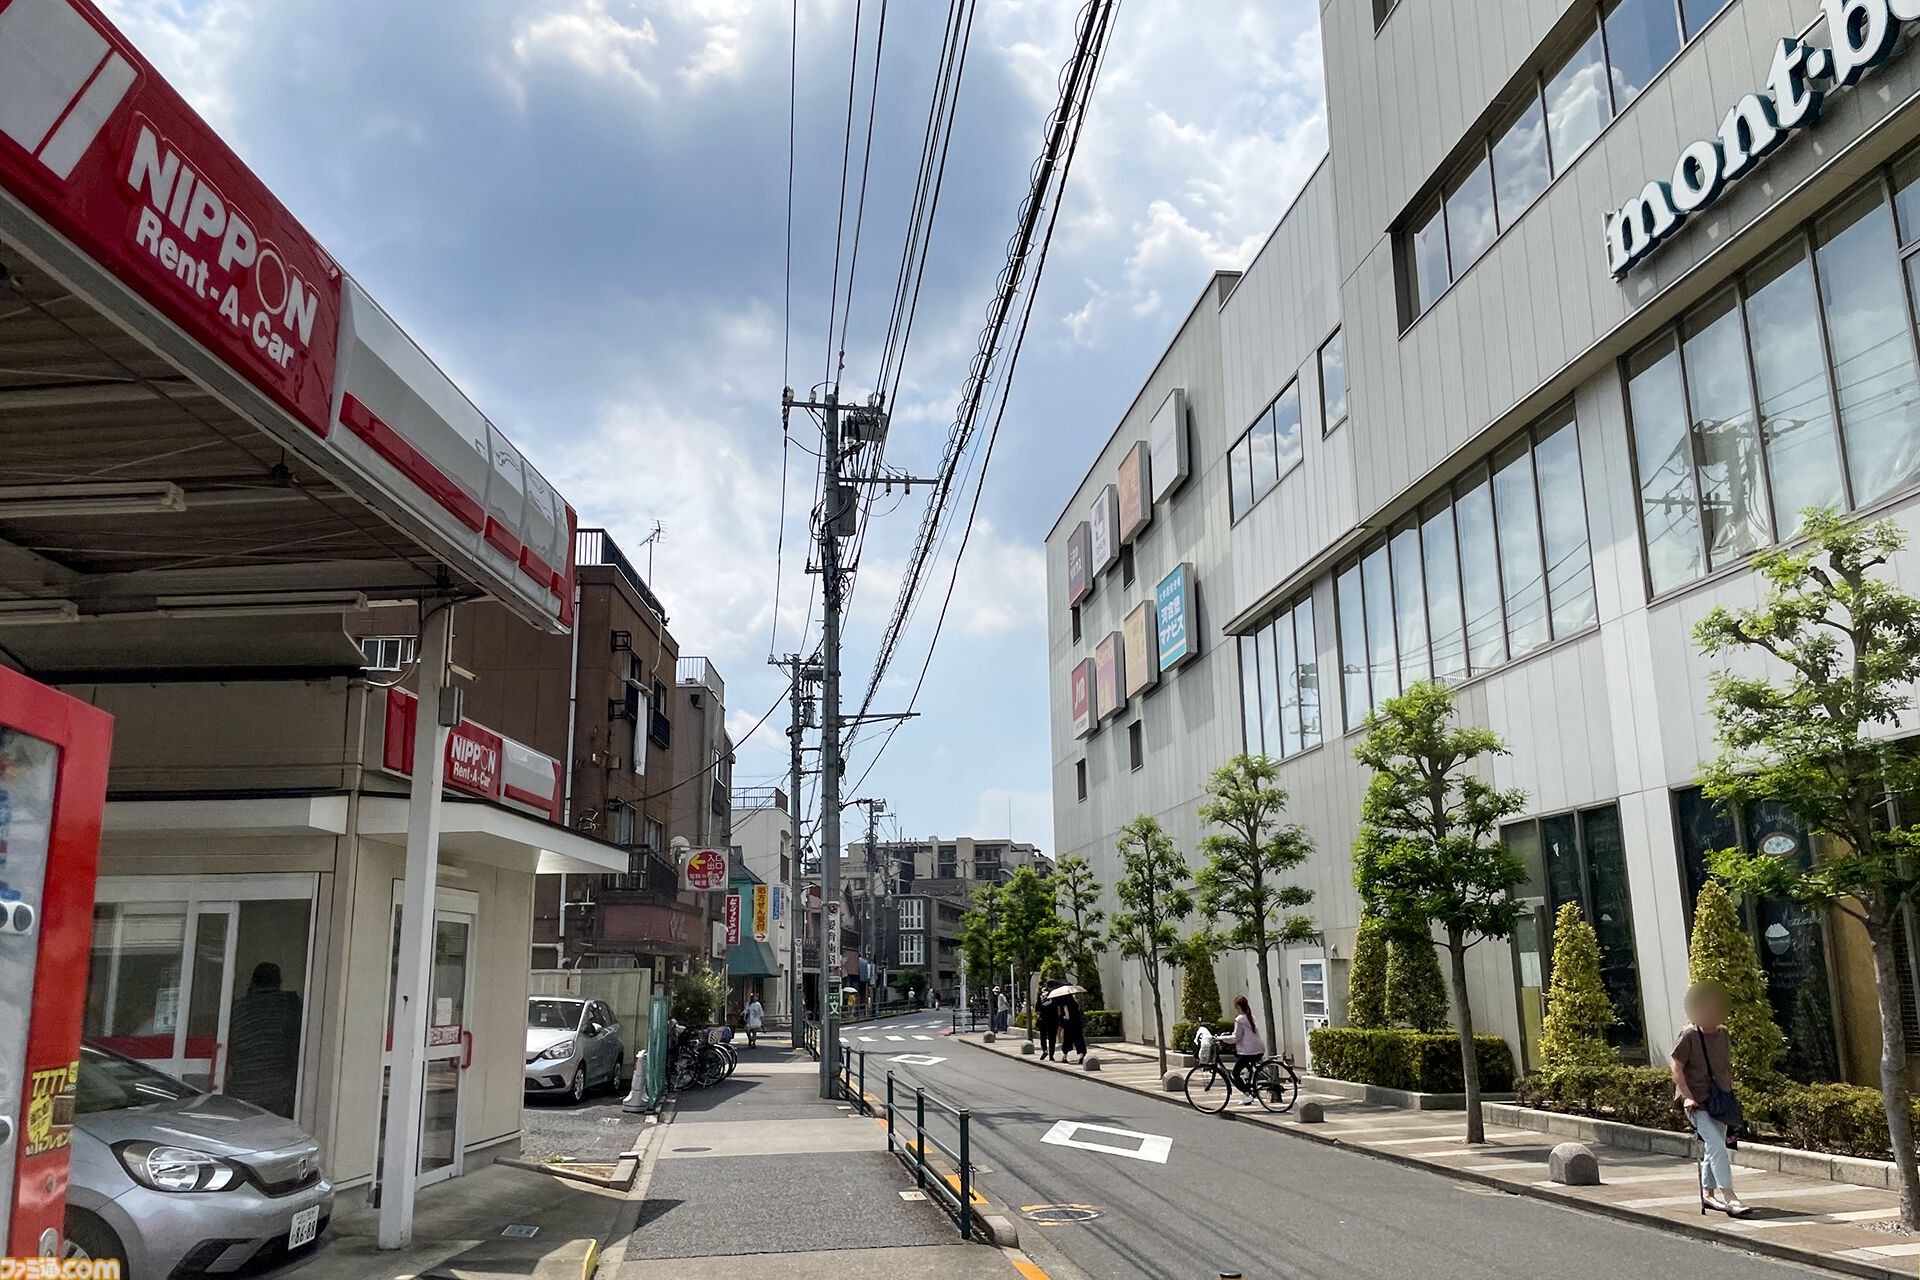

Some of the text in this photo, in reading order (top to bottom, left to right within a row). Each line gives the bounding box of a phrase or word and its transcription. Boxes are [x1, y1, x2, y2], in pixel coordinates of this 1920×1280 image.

[127, 125, 318, 347] NIPPON
[135, 205, 295, 369] Rent-A-Car
[1161, 594, 1181, 626] 河合塾
[1160, 614, 1184, 645] マナビス
[451, 734, 497, 775] NIPPON
[707, 862, 723, 870] 出口
[756, 887, 767, 931] 処方せん受付
[829, 1000, 839, 1015] 文
